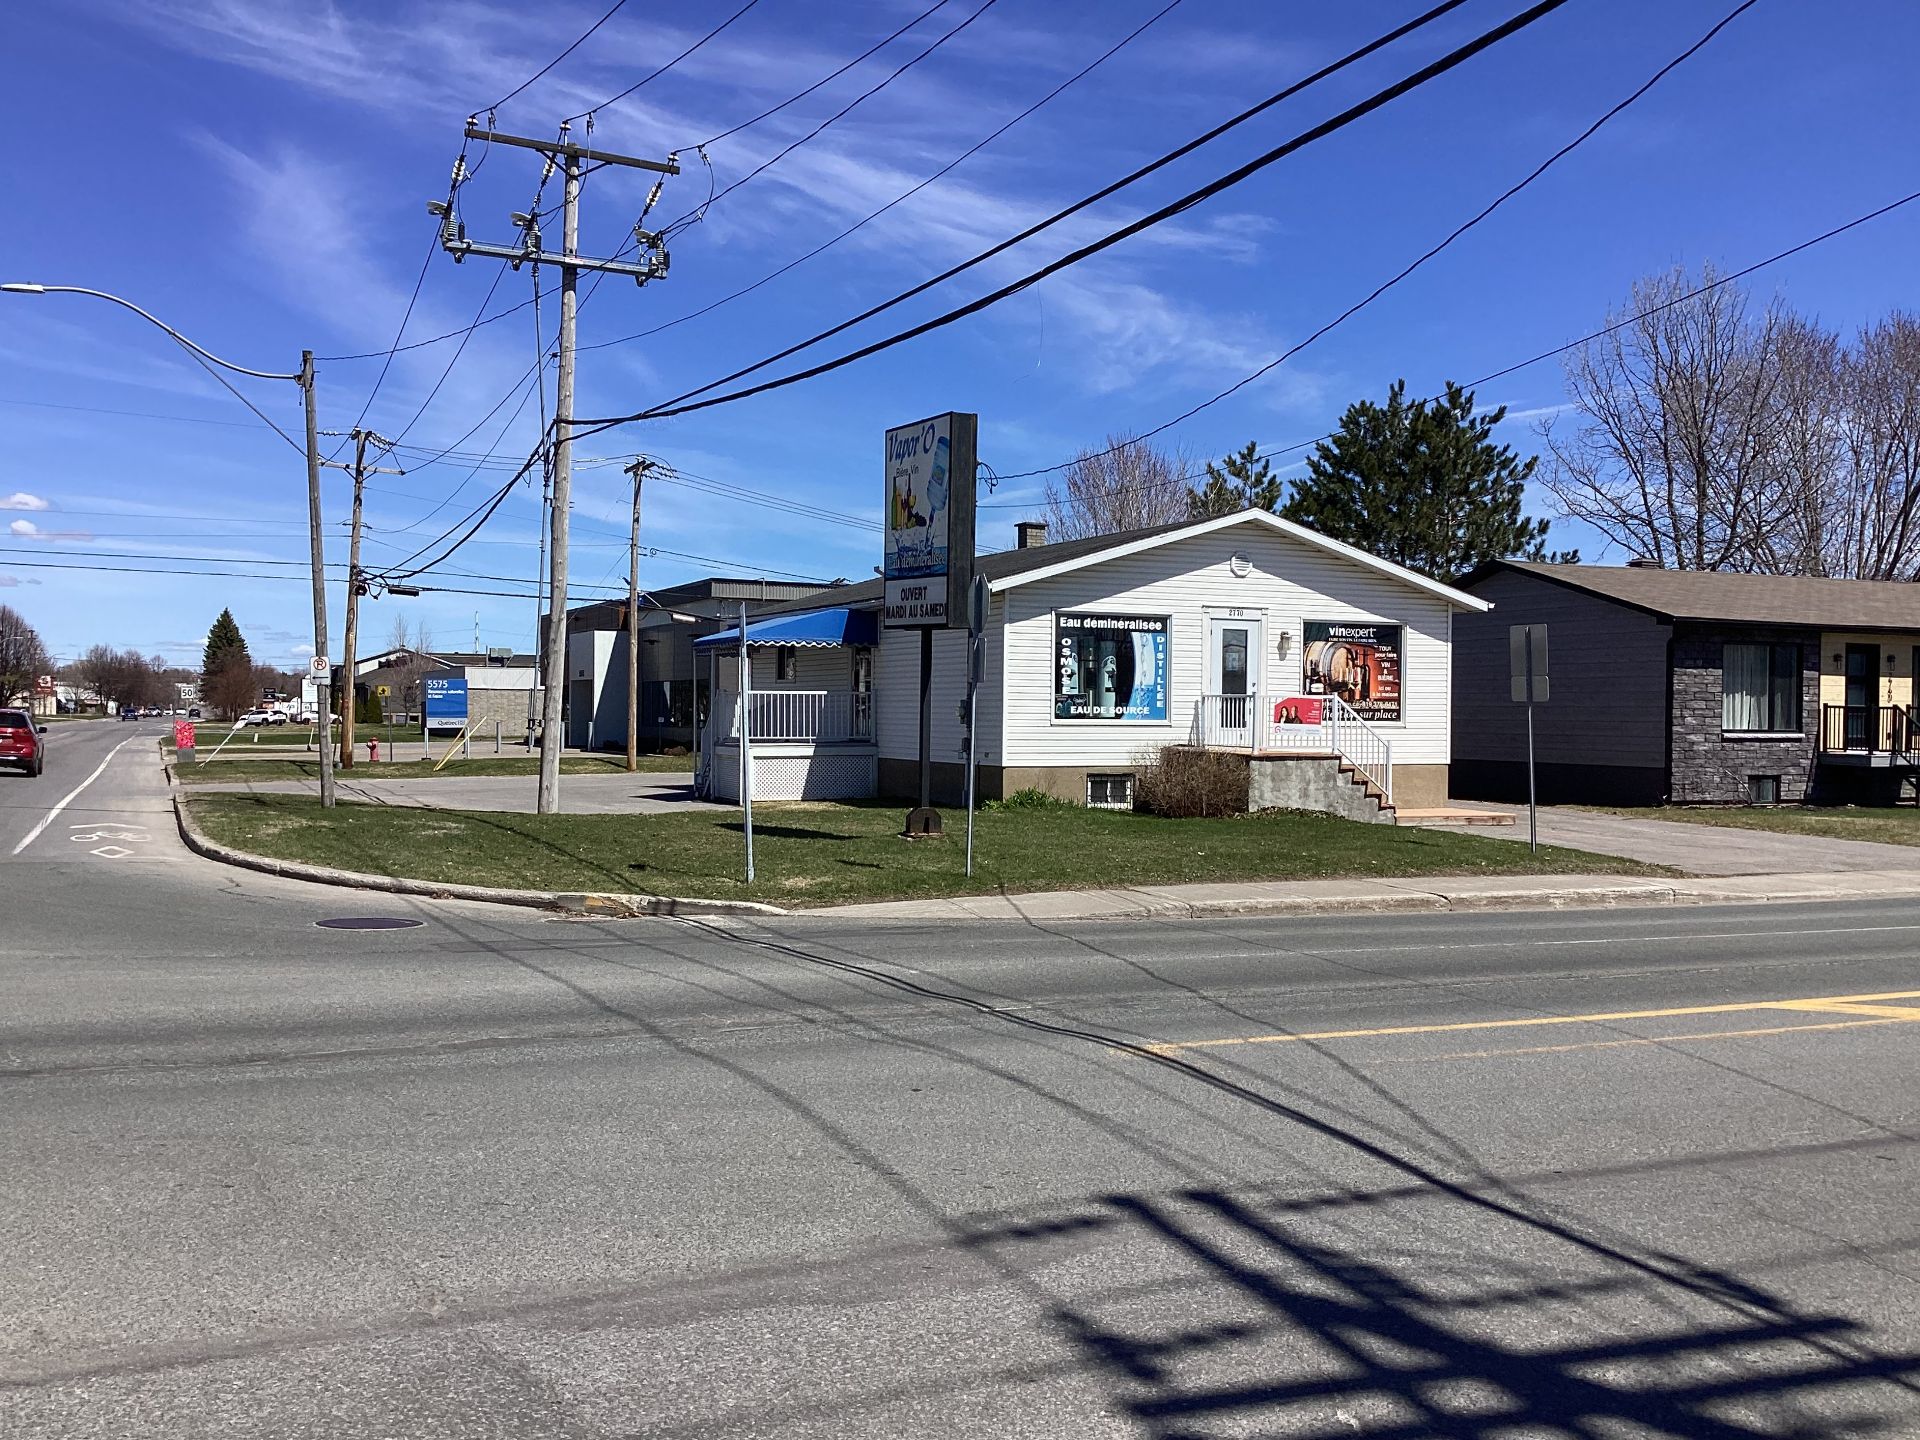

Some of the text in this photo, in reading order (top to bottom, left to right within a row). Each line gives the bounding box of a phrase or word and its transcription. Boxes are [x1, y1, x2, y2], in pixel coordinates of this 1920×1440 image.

[889, 423, 935, 466] Vapor'O
[911, 465, 919, 474] Vin
[900, 586, 928, 601] OUVERT
[886, 602, 947, 619] MARDI AU SAMEDI
[1229, 609, 1243, 617] 2770
[1060, 617, 1162, 630] Eau déminéralisée
[1328, 625, 1375, 638] vinexpert
[1060, 637, 1073, 694] OSMOSE
[427, 680, 448, 689] 5575
[182, 688, 193, 697] 50
[1070, 706, 1150, 715] EAU DE SOURCE
[1375, 709, 1397, 720] place
